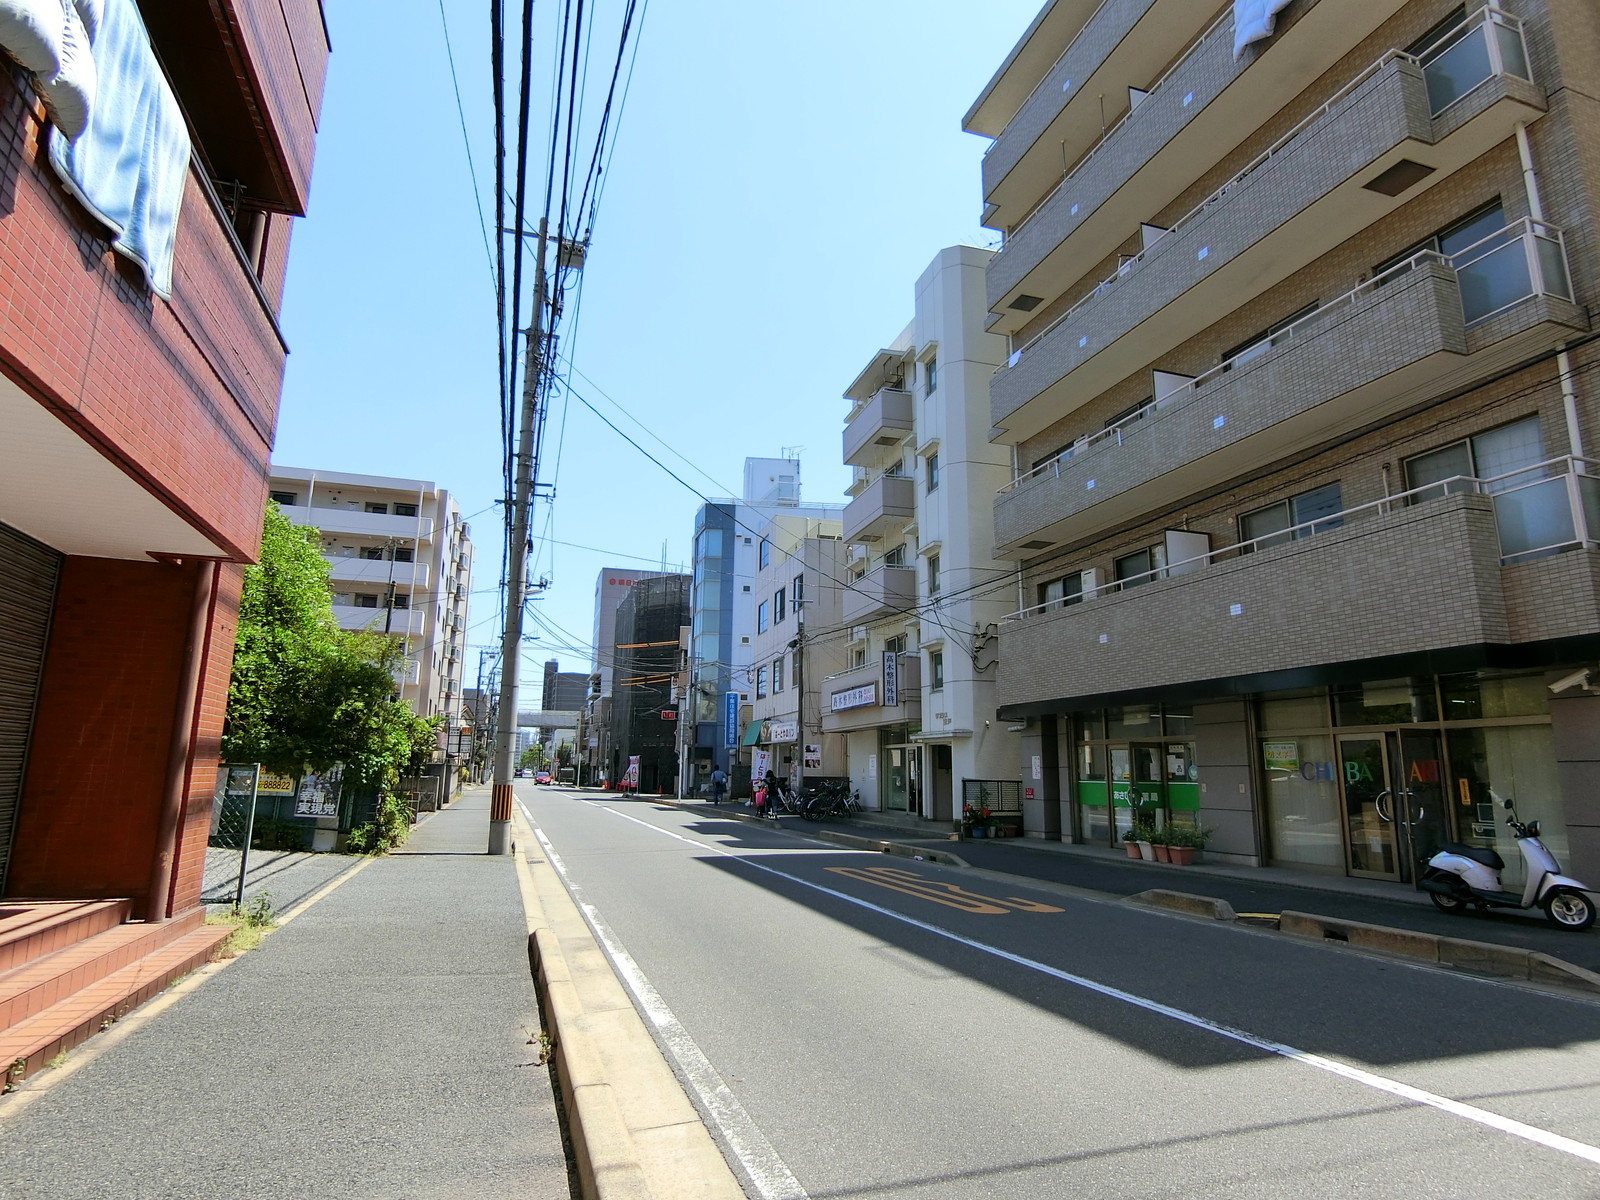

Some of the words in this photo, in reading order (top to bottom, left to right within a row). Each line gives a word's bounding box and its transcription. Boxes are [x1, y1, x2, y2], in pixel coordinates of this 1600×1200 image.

[300, 791, 326, 803] 幸福
[297, 802, 336, 815] 実現党
